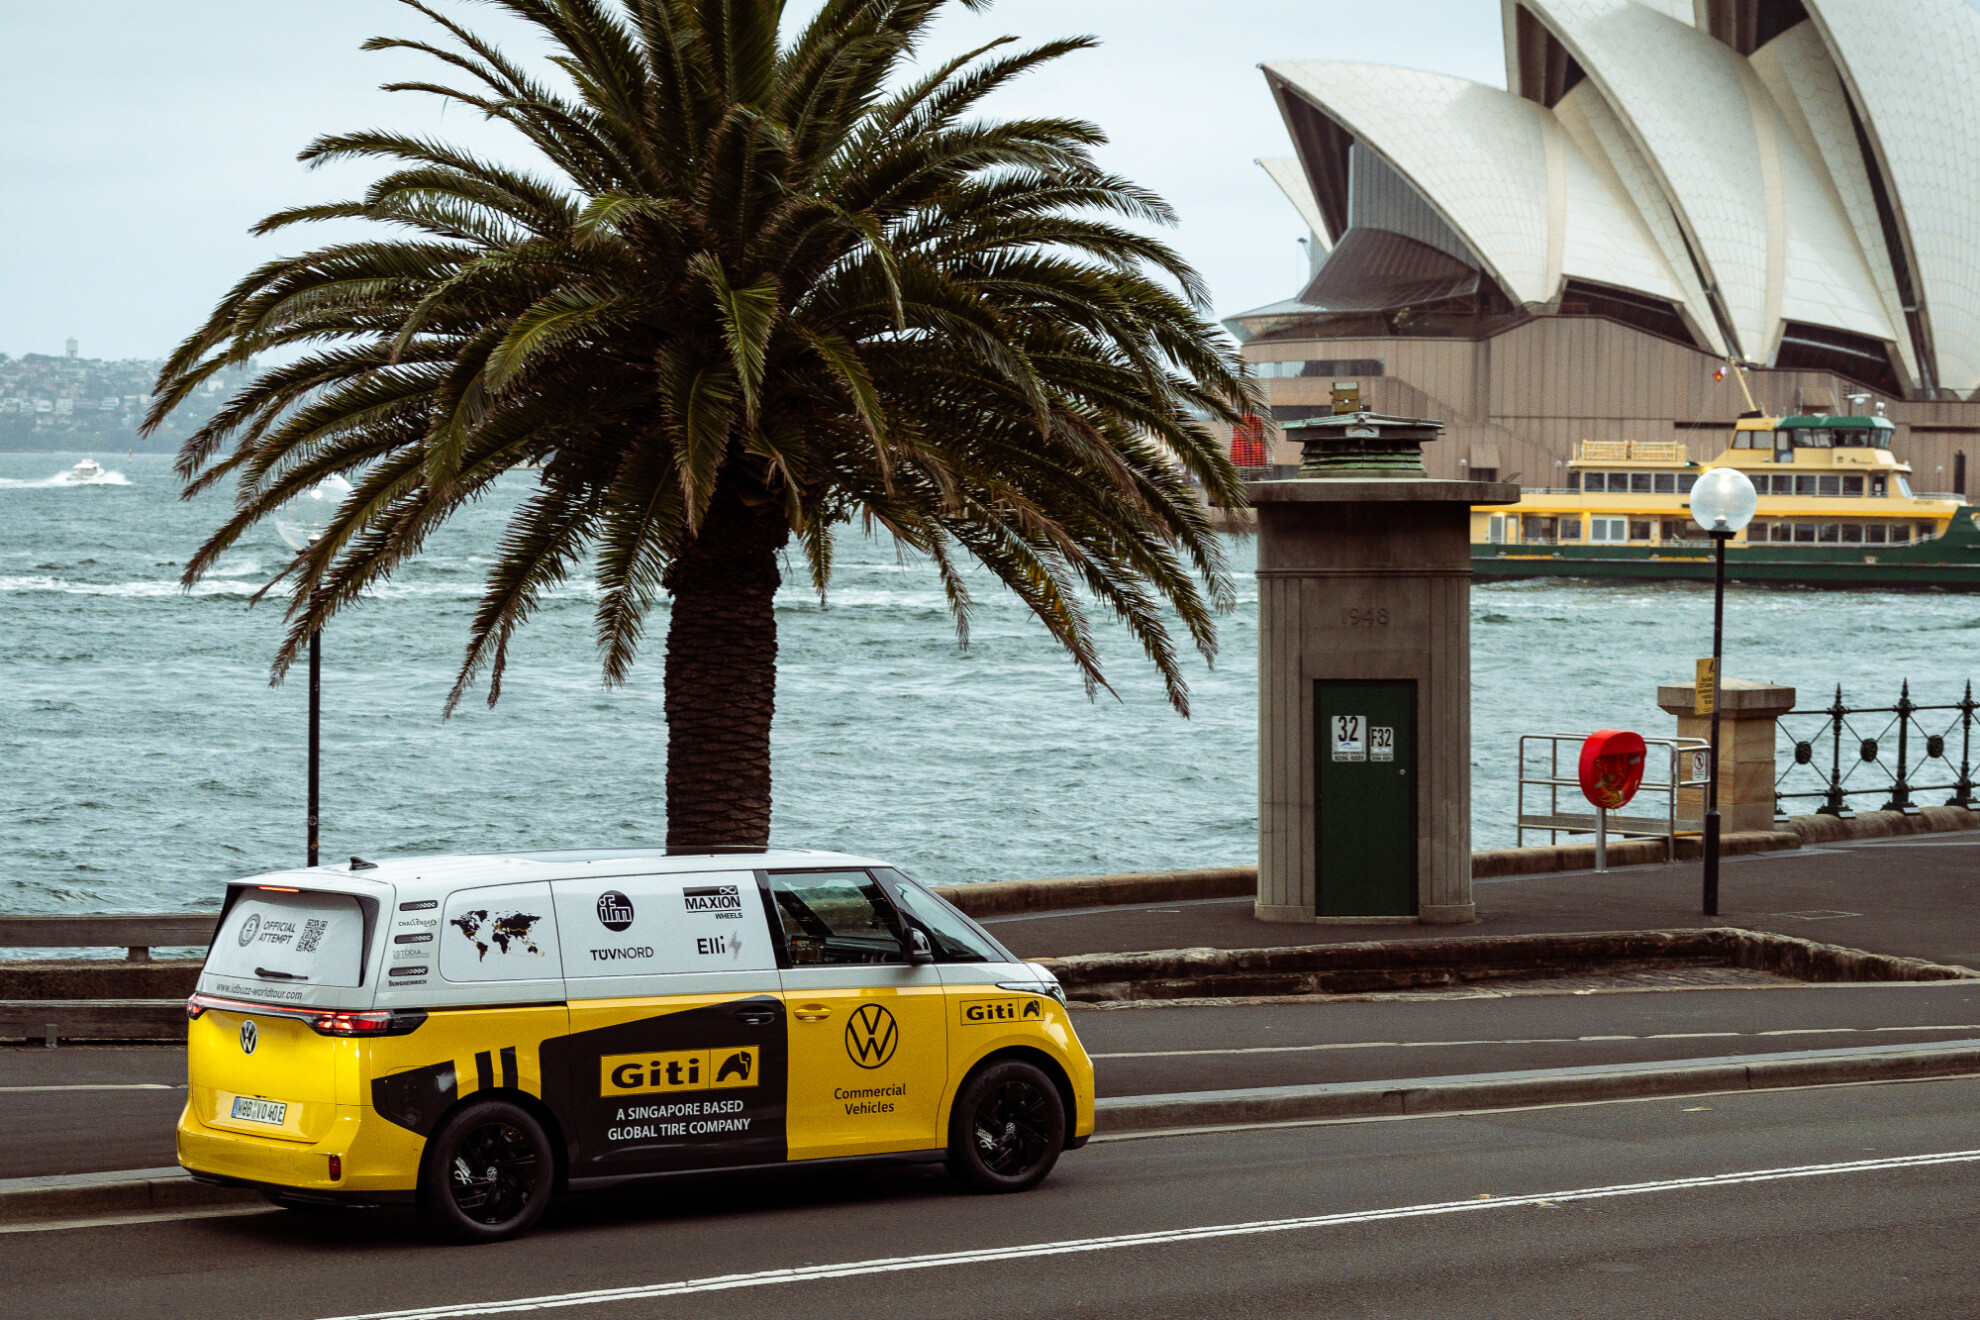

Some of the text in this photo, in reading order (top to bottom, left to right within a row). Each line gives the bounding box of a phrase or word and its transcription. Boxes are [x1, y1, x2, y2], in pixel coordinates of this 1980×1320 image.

[1338, 716, 1359, 742] 32
[1371, 728, 1392, 747] F32
[599, 895, 633, 923] ifm
[685, 896, 741, 910] MAXION
[715, 912, 743, 920] WHEELS
[263, 921, 296, 933] OFFICIAL
[258, 933, 293, 944] ATTEMPT
[697, 935, 726, 955] Elli
[216, 983, 303, 1000] www.idbuzz-worldtour.com
[966, 1003, 1015, 1021] Giti
[611, 1058, 699, 1088] Giti
[834, 1083, 906, 1100] Commercial
[616, 1100, 744, 1121] A SINGAPORE BASED
[844, 1101, 895, 1115] Vehicles
[608, 1118, 751, 1140] GLOBAL TIRE COMPANY
